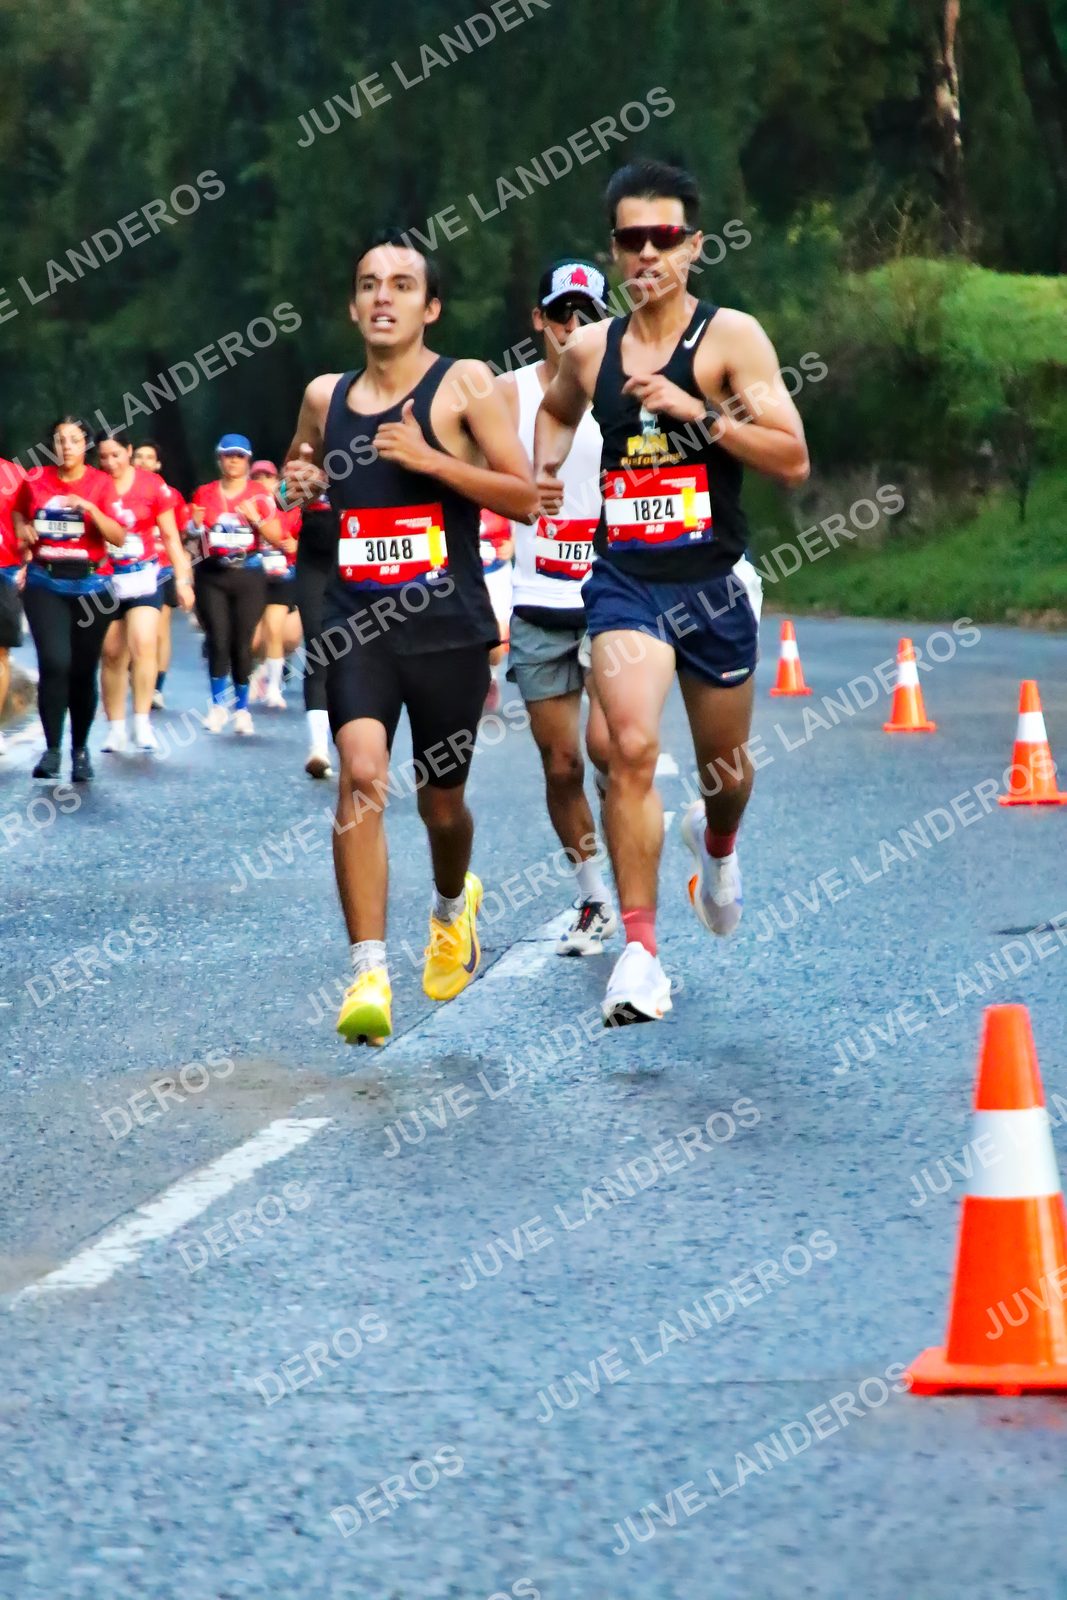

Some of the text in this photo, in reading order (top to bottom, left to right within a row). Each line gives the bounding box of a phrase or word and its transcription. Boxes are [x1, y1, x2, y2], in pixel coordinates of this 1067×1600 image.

[633, 497, 675, 521] 1824
[365, 538, 413, 562] 3048
[558, 543, 591, 560] 1767
